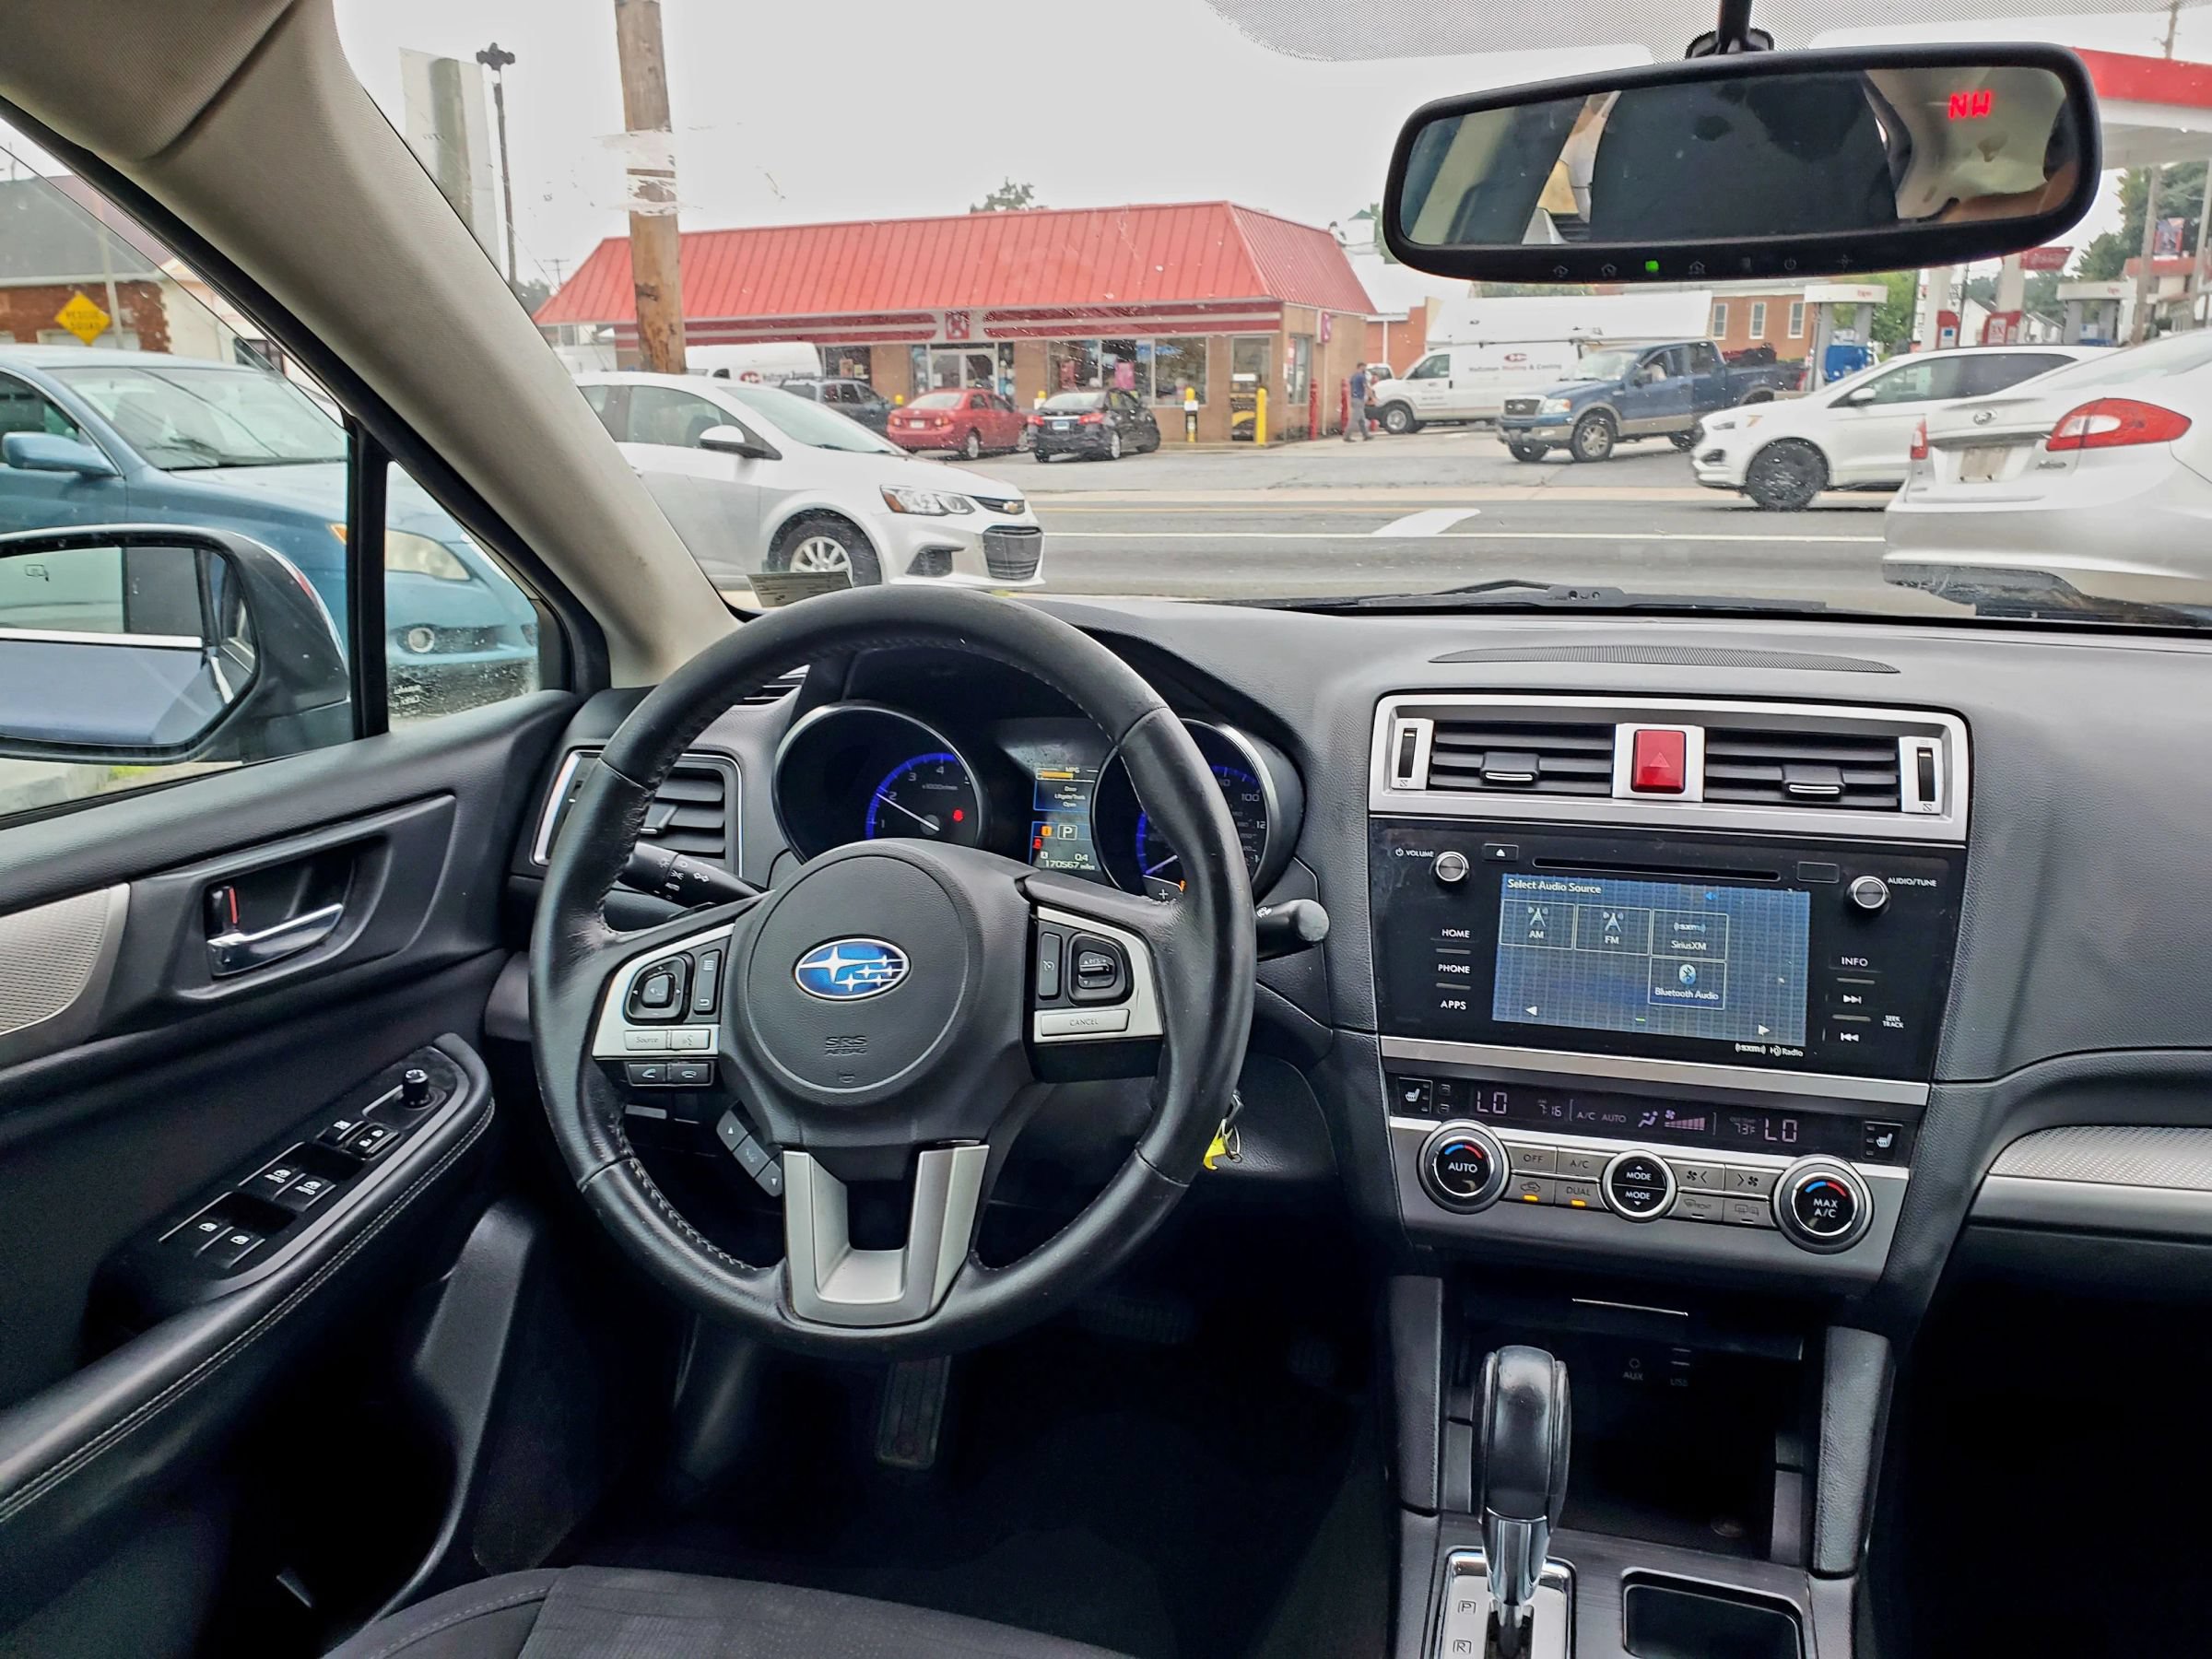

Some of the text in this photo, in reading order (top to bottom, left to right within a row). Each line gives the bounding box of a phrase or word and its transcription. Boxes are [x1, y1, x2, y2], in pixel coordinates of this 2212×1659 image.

[1948, 90, 1991, 118] NW
[936, 766, 945, 774] 4
[908, 772, 917, 782] 3
[888, 792, 898, 801] 2
[1241, 794, 1260, 802] 100
[1406, 850, 1434, 858] VOLUME
[1045, 860, 1079, 869] 170567
[1507, 878, 1602, 894] Select Audio Source
[1888, 877, 1937, 888] AUDIO/TUNE
[1441, 928, 1471, 938] HOME
[1529, 930, 1545, 939] AM
[1605, 935, 1619, 945] FM
[1671, 940, 1707, 951] SiriusXM
[1841, 956, 1868, 967] INFO
[1438, 963, 1471, 974] PHONE
[1654, 987, 1720, 1000] Bluetooth Audio
[1440, 1000, 1467, 1010] APPS
[1070, 1018, 1099, 1027] CANCEL
[1882, 1020, 1904, 1029] TRACK
[826, 1036, 867, 1047] SRS
[1577, 1112, 1595, 1121] A/C
[1601, 1114, 1627, 1123] AUTO
[1524, 1154, 1543, 1162] OFF
[1448, 1161, 1477, 1173] AUTO
[1570, 1159, 1589, 1169] A/C
[1626, 1171, 1652, 1181] MODE
[1567, 1186, 1591, 1196] DUAL
[1625, 1191, 1651, 1200] MODE
[1813, 1198, 1838, 1208] MAX
[1814, 1208, 1837, 1218] A/C
